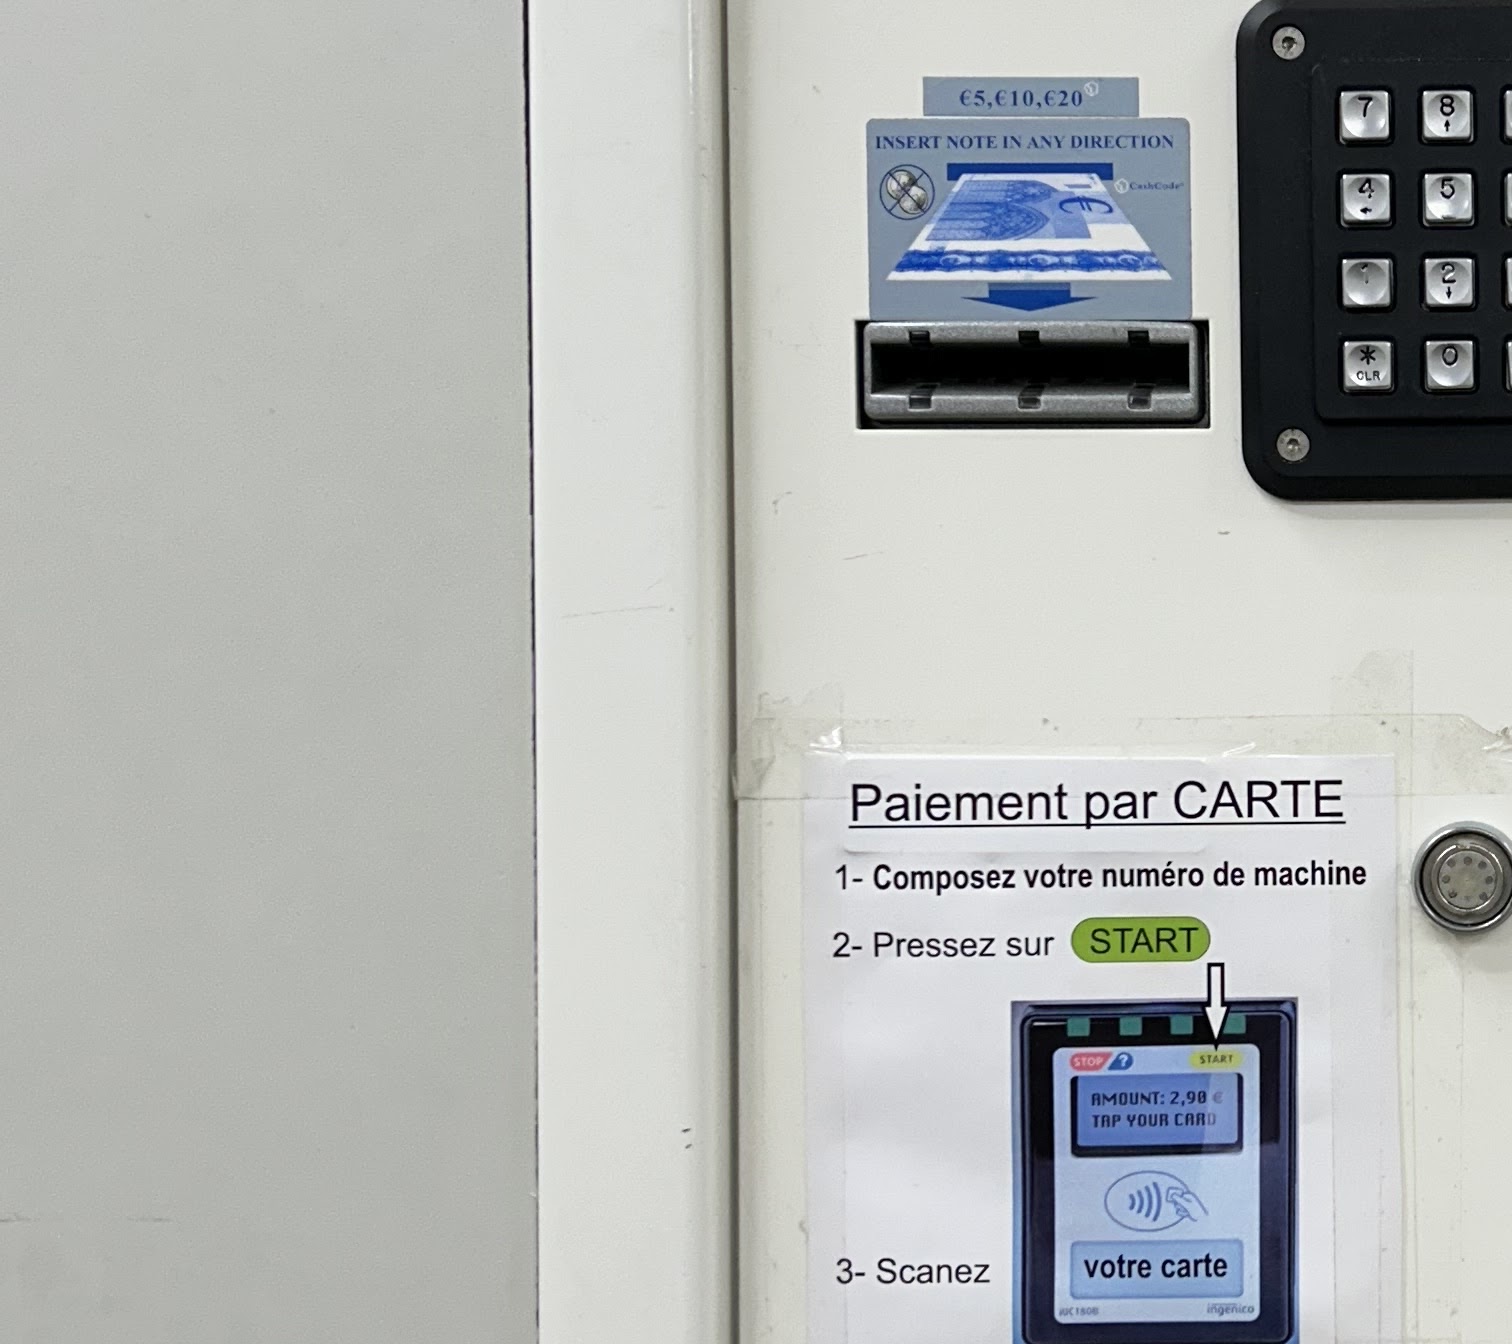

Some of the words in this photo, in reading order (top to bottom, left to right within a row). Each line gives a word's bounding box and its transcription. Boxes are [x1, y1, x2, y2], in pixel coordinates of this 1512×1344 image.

[1357, 96, 1373, 117] 7
[1439, 95, 1455, 117] 8
[875, 135, 943, 150] INSERT
[946, 135, 998, 150] NOTE
[1002, 135, 1022, 150] IN
[1027, 135, 1067, 149] ANY
[1071, 134, 1175, 149] DIRECTION
[1359, 178, 1375, 199] 4
[1440, 178, 1455, 199] 5
[1441, 264, 1457, 284] 2
[1356, 370, 1381, 381] CLR
[851, 783, 1068, 822] Paiement
[1085, 789, 1157, 829] par
[1174, 779, 1344, 819] CARTE
[835, 864, 863, 890] 1-
[873, 863, 1015, 896] Composez
[1024, 863, 1093, 888] votre
[1102, 861, 1204, 887] numéro
[1213, 861, 1245, 887] de
[1254, 860, 1367, 886] machine
[833, 932, 863, 957] 2-
[874, 932, 996, 957] Pressez
[1006, 935, 1055, 956] sur
[1090, 927, 1199, 954] START
[1073, 1056, 1102, 1067] STOP
[1199, 1054, 1233, 1065] START
[1091, 1091, 1165, 1107] AMOUNT:
[1170, 1090, 1207, 1107] 2,90
[1092, 1114, 1121, 1128] TAP
[1126, 1113, 1169, 1127] YOUR
[1174, 1112, 1216, 1127] CARD
[836, 1258, 866, 1285] 3-
[876, 1257, 990, 1285] Scanez
[1084, 1255, 1151, 1279] votre
[1161, 1253, 1228, 1278] carte
